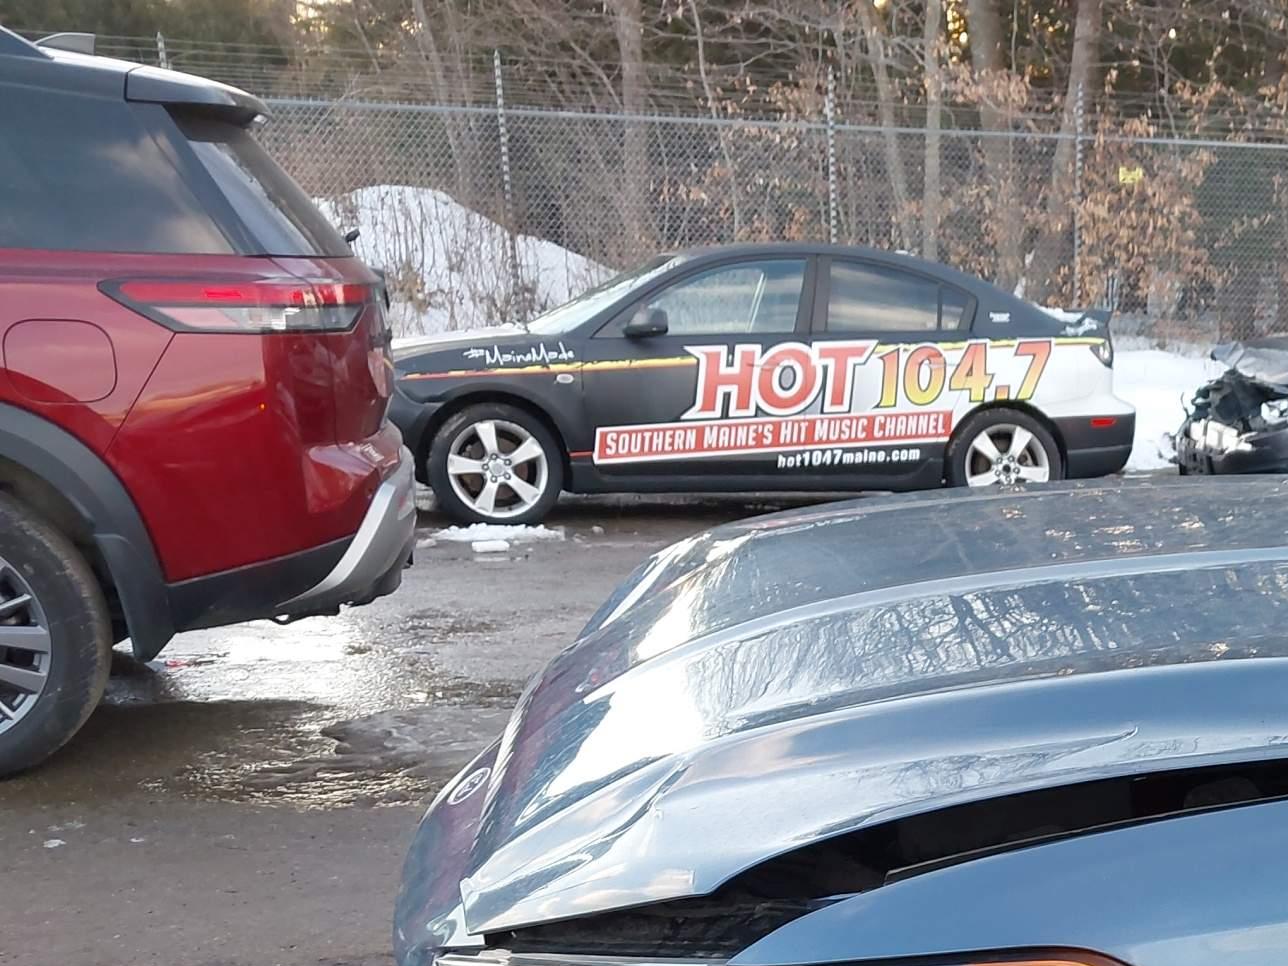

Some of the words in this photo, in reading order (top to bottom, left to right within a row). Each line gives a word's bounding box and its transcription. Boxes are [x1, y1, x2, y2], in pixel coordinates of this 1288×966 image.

[463, 341, 575, 365] #MaineMade
[682, 340, 878, 420] HOT
[877, 340, 1052, 408] 104.7
[605, 427, 696, 455] SOUTHERN
[703, 421, 774, 449] MAINE'S
[780, 419, 810, 444] HIT
[814, 415, 869, 442] MUSIC
[873, 411, 945, 436] CHANNEL
[777, 446, 920, 469] hot1047maine.com
